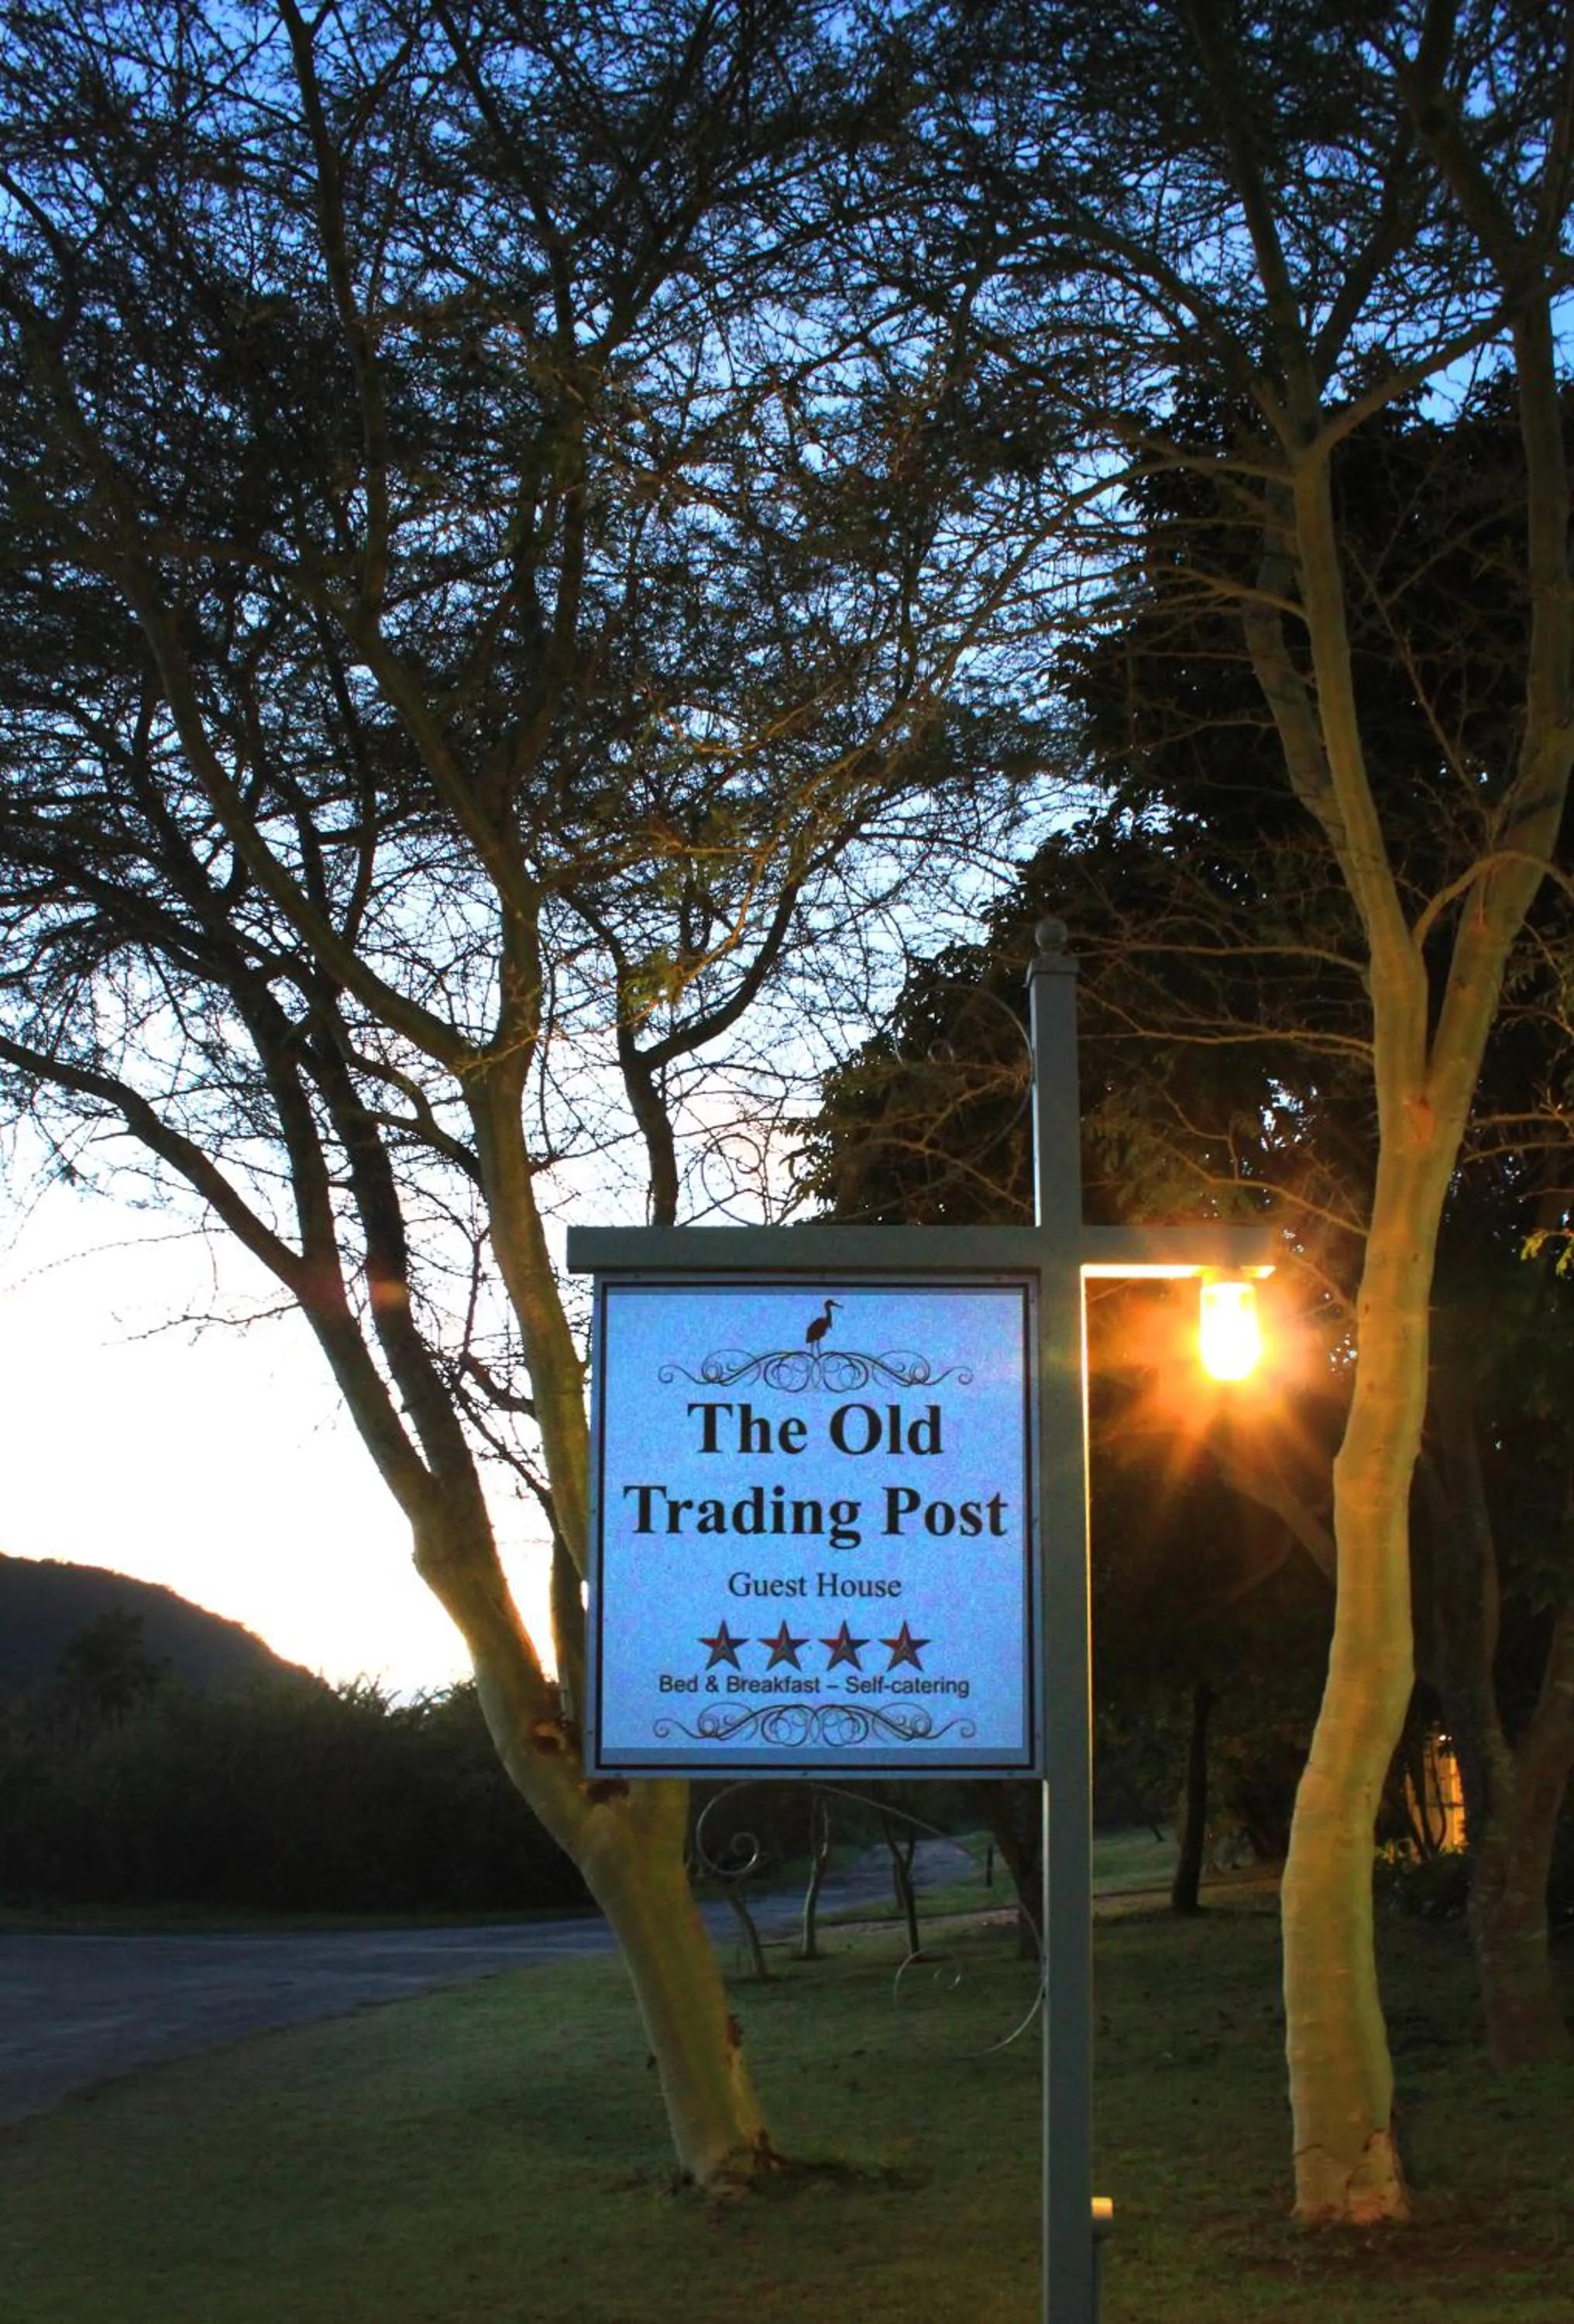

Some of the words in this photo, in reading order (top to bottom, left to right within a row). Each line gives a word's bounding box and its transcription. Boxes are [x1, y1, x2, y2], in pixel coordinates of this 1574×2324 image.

[688, 1404, 807, 1455] The
[830, 1404, 943, 1456] Old
[624, 1486, 862, 1550] Trading
[882, 1487, 1008, 1537] Post
[728, 1572, 807, 1597] Guest
[816, 1572, 902, 1597] House
[658, 1673, 699, 1694] Bed
[704, 1674, 720, 1694] &
[726, 1674, 822, 1695] Breakfast
[844, 1675, 970, 1700] Self-catering
